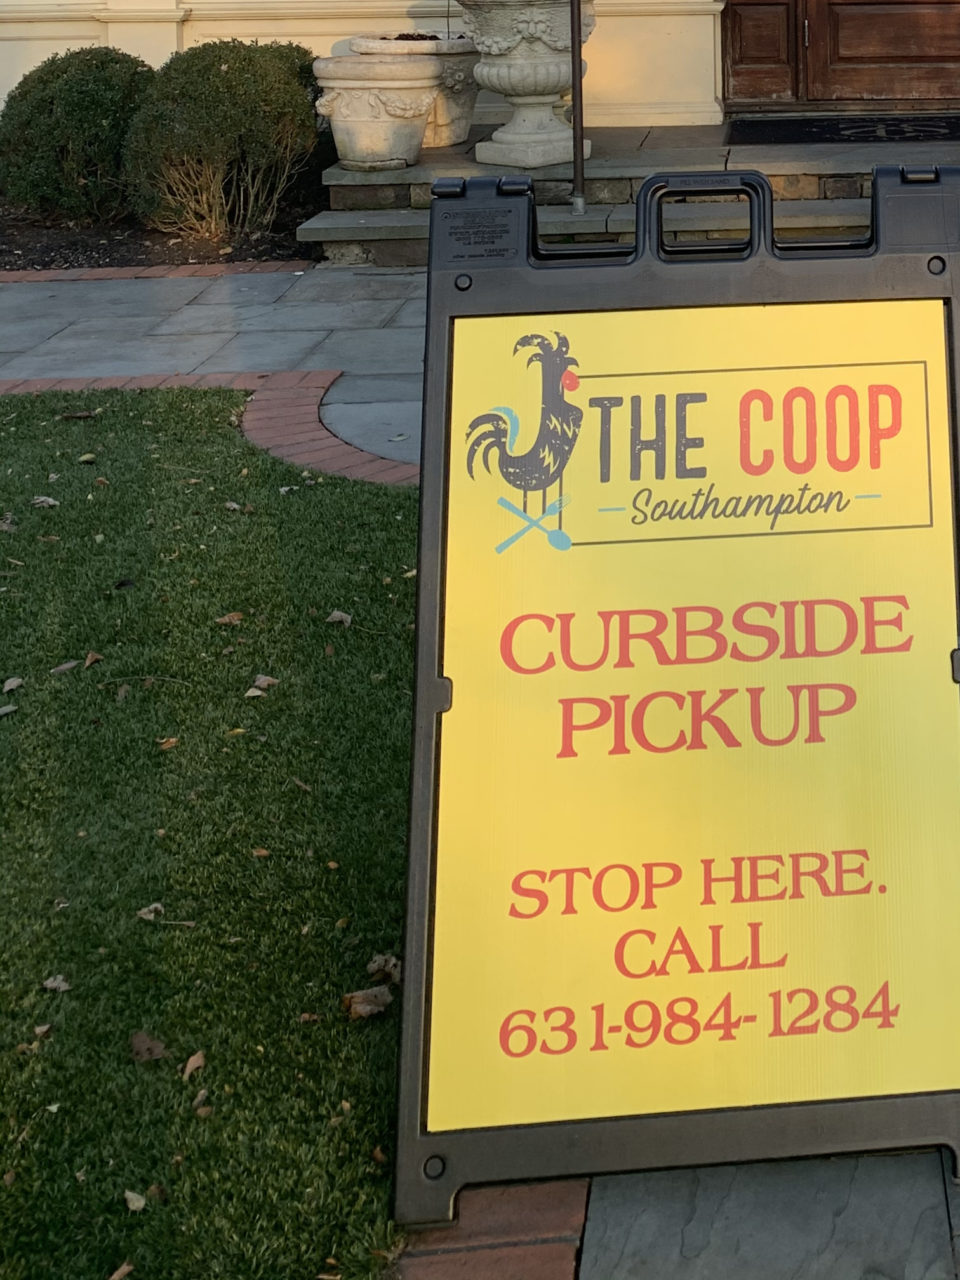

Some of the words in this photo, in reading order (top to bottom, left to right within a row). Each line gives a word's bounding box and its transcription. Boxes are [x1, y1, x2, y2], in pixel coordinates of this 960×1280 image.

[588, 392, 708, 483] THE
[739, 384, 903, 476] COOP
[630, 483, 851, 531] Southampton
[499, 595, 914, 675] CURBSIDE
[556, 683, 857, 759] PICKUP
[508, 862, 683, 920] STOP
[700, 849, 887, 907] HERE.
[613, 922, 788, 979] CALL
[499, 980, 900, 1058] 631-984-1284
